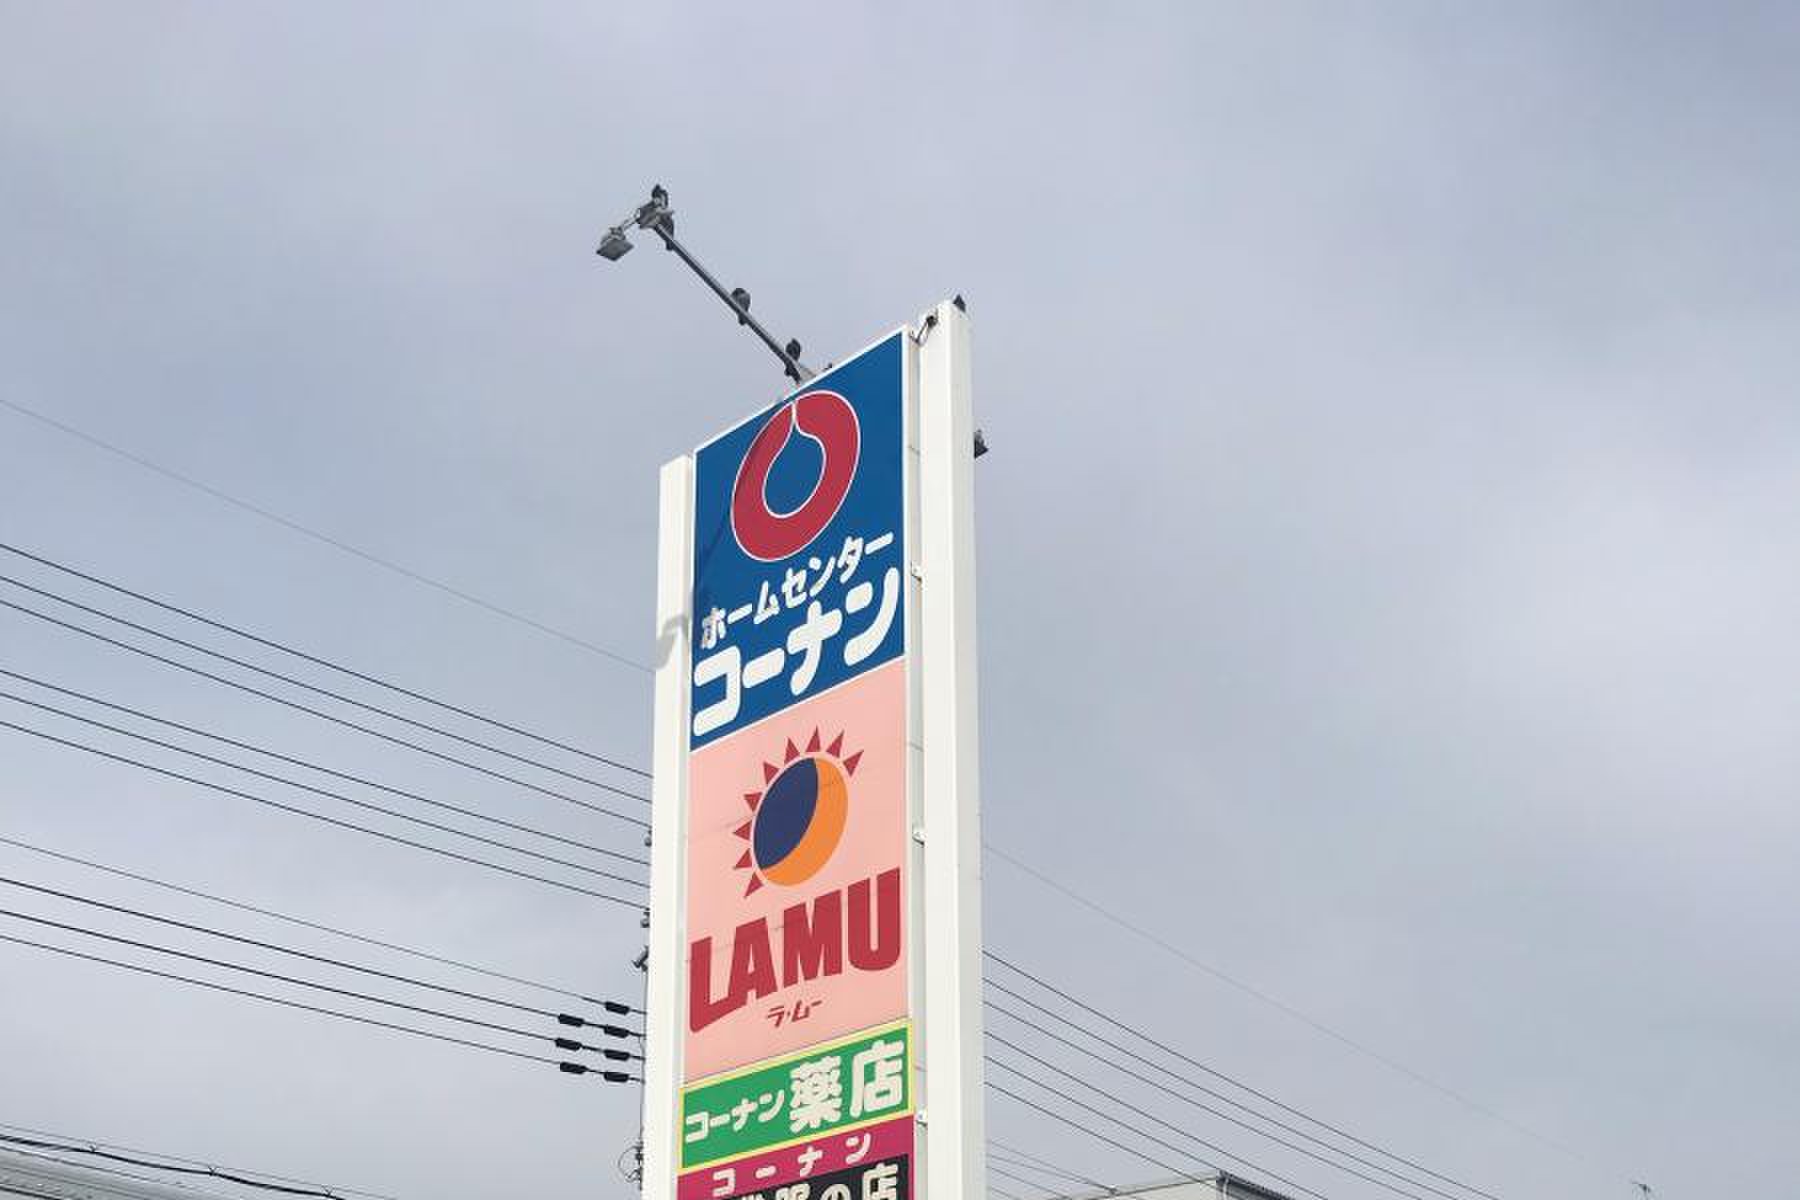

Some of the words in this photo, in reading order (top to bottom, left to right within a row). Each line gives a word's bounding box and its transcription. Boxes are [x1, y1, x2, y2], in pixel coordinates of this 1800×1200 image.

[693, 566, 900, 737] コーナン
[700, 532, 894, 649] ホームセンター
[690, 867, 901, 1033] LAMU
[712, 1133, 872, 1197] コーナン
